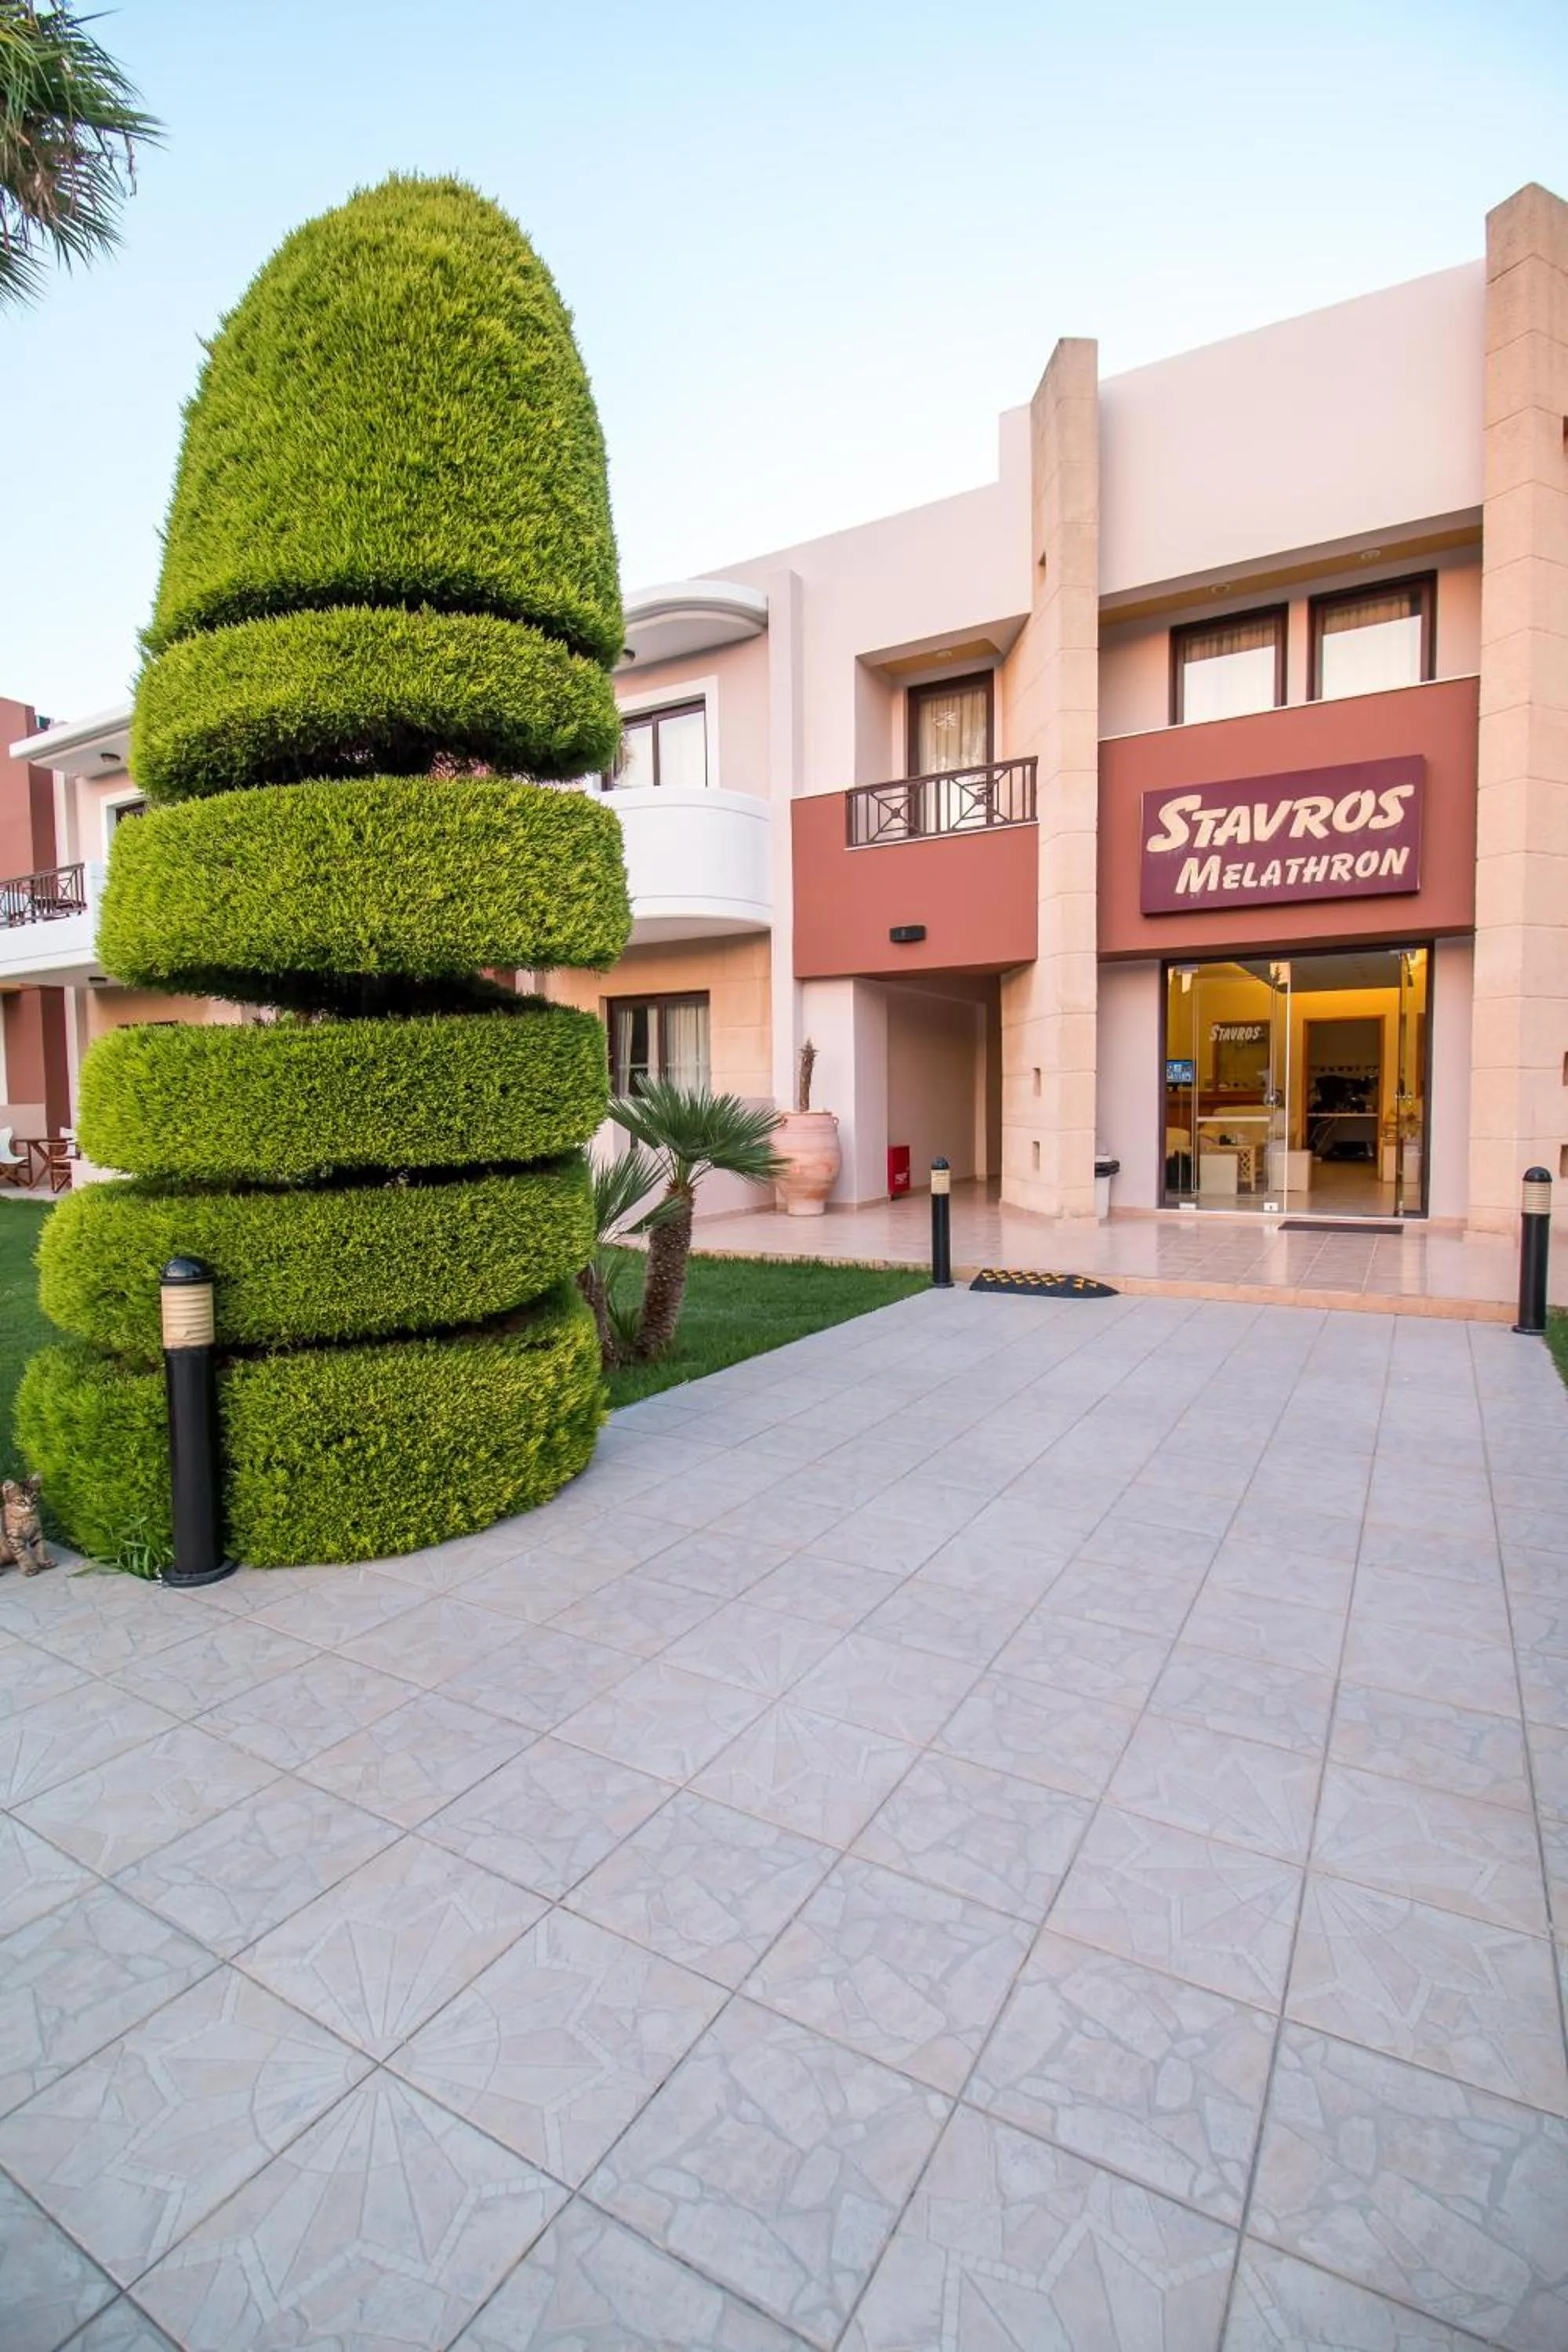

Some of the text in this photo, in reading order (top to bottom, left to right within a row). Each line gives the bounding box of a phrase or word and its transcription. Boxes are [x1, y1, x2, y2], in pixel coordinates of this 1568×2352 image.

[1147, 785, 1414, 852] STAVROS
[1175, 847, 1410, 894] MELATHRON
[1209, 1024, 1261, 1041] STAVROS
